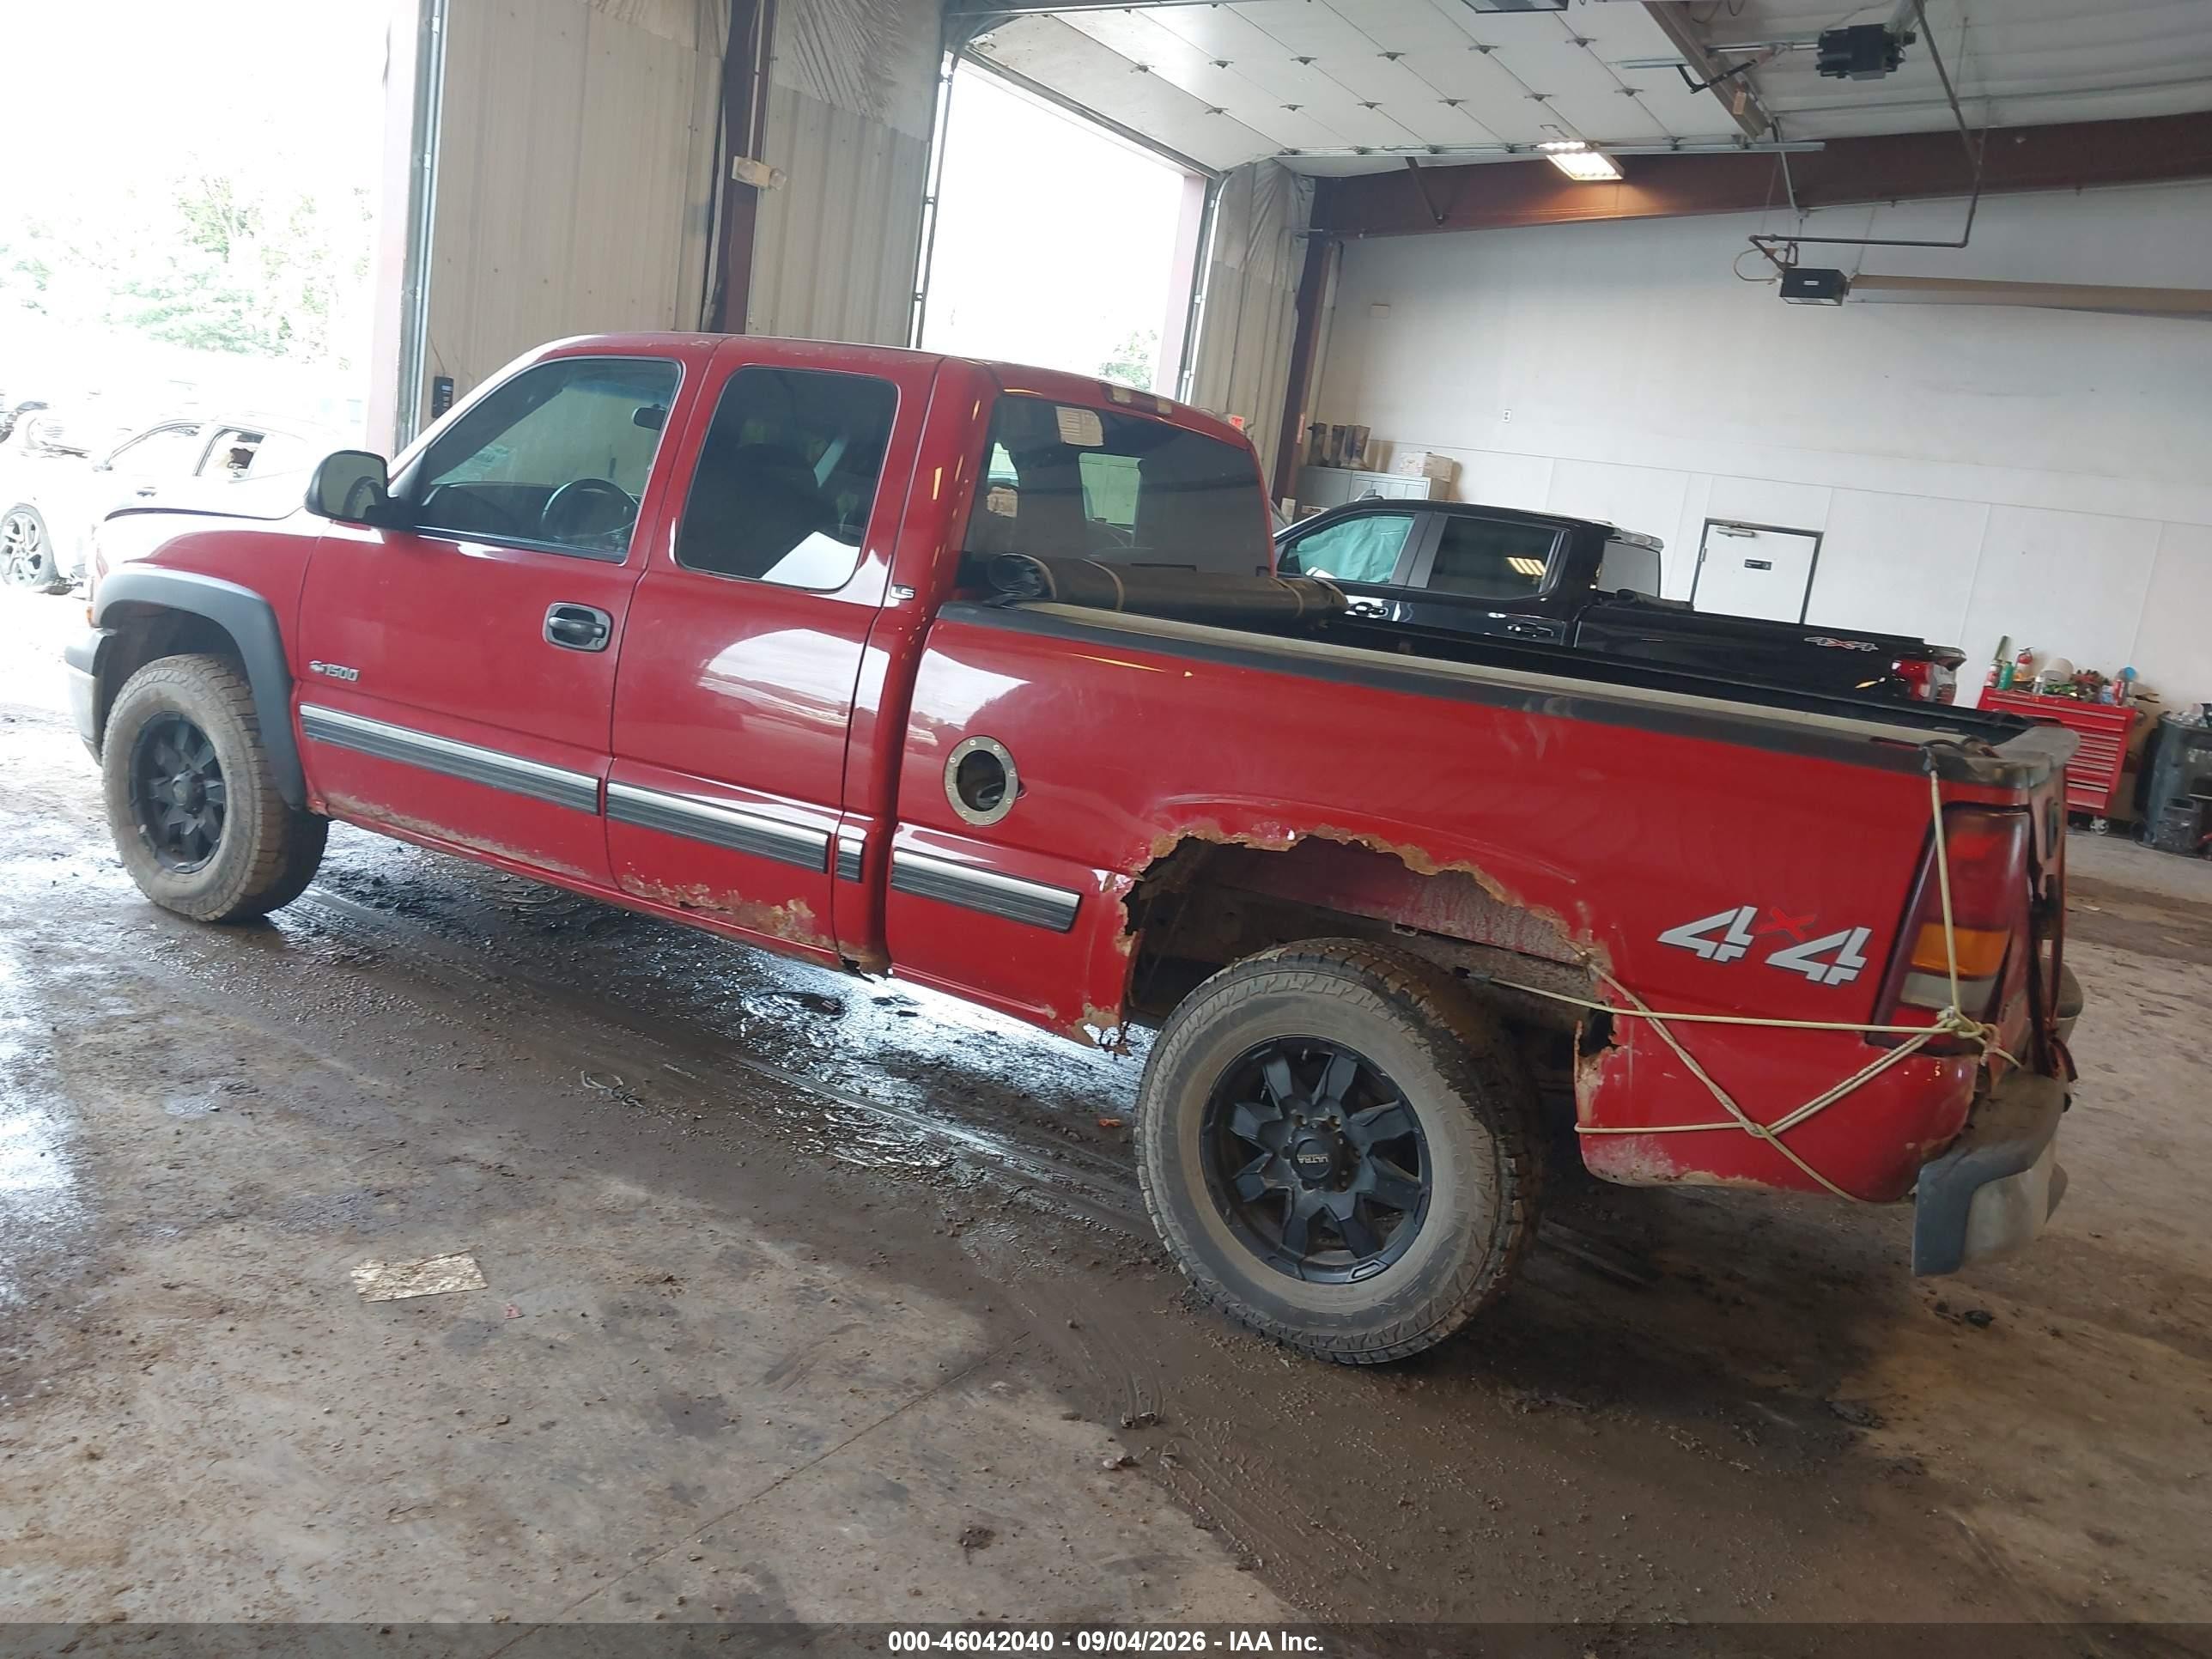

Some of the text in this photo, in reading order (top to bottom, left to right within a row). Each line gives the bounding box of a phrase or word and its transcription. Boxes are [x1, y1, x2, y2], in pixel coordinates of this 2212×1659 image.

[890, 586, 915, 599] LS
[325, 663, 359, 682] 1500
[1297, 1153, 1329, 1164] ULTRA
